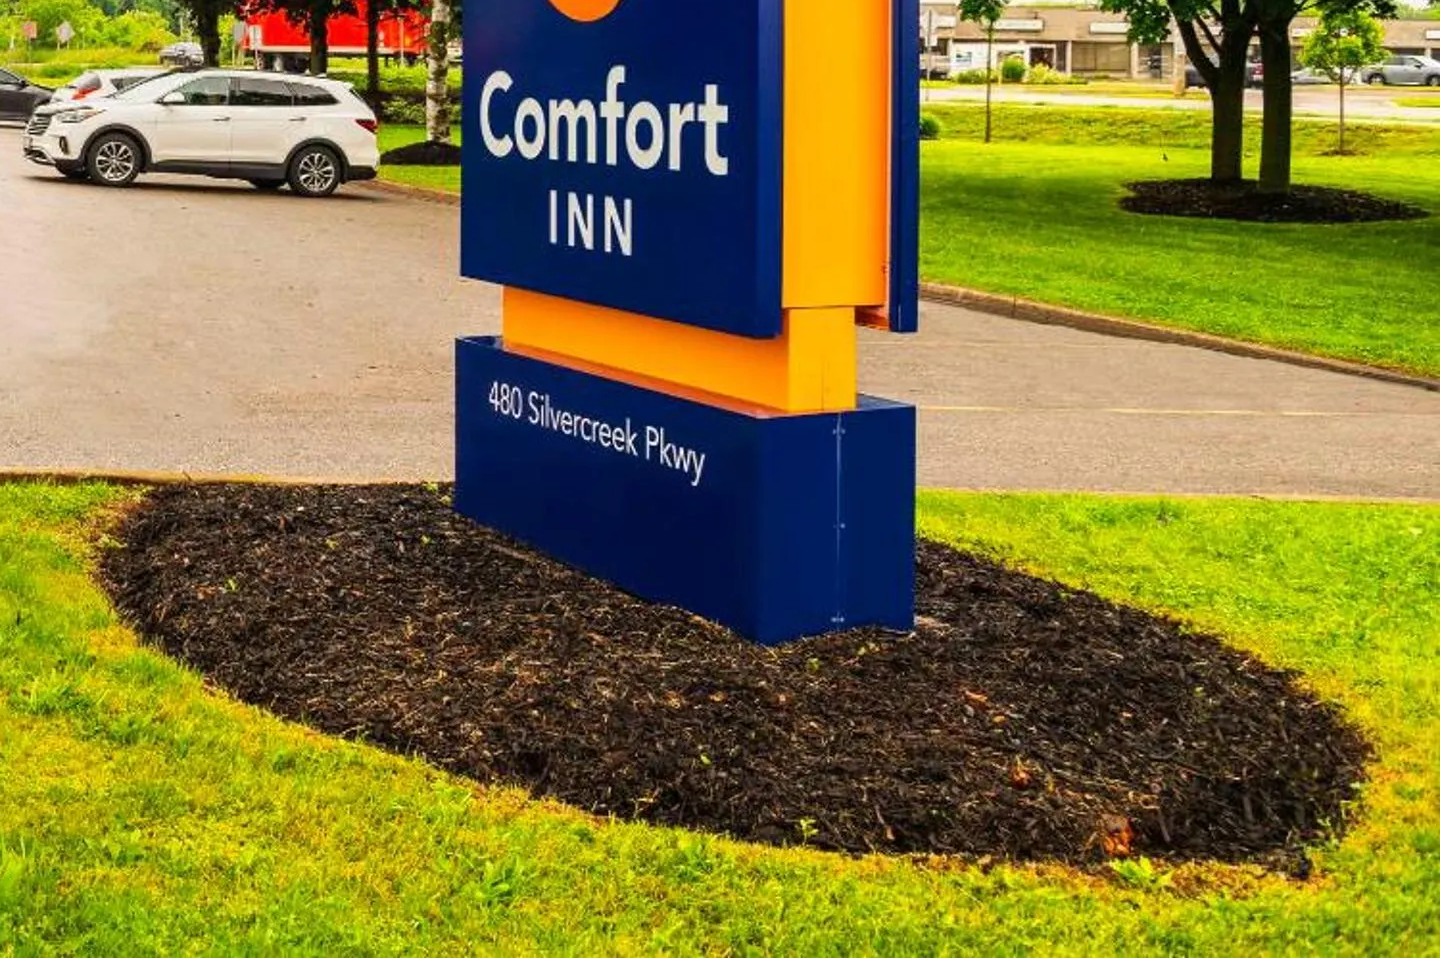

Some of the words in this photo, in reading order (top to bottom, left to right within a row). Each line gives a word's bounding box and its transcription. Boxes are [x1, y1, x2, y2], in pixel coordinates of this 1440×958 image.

[479, 65, 729, 176] Comfort
[548, 189, 633, 256] INN
[488, 380, 523, 419] 480
[528, 390, 639, 457] Silvercreek
[645, 425, 707, 487] Pkwy
